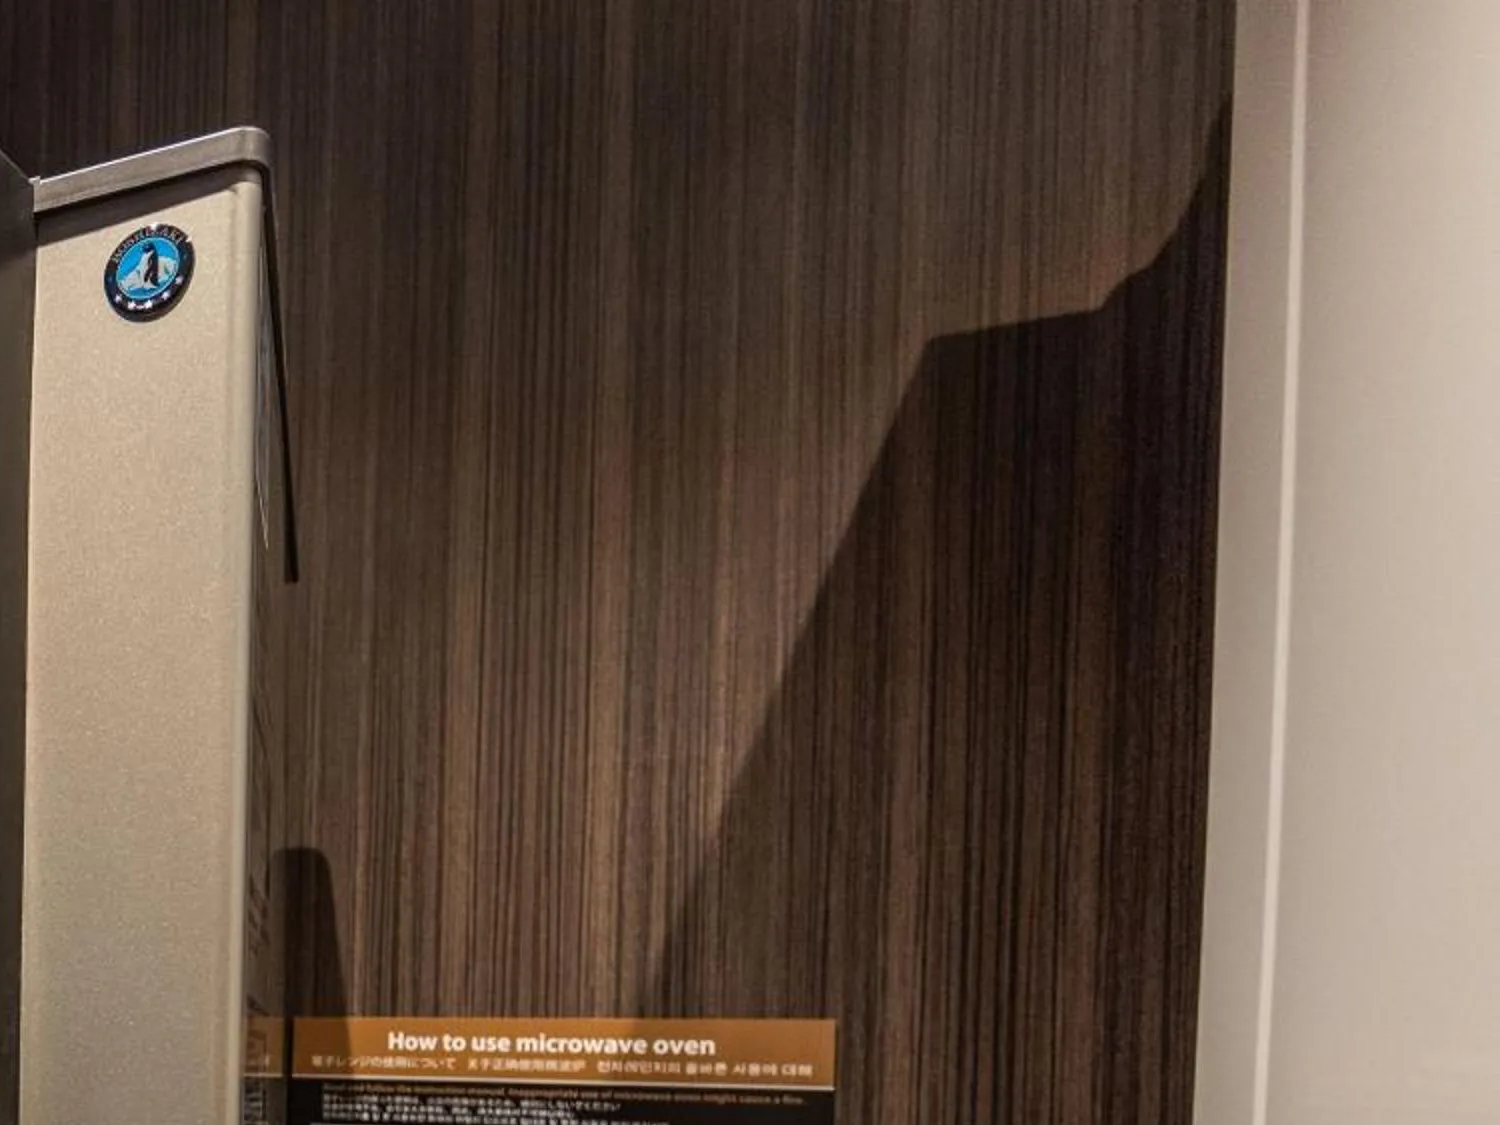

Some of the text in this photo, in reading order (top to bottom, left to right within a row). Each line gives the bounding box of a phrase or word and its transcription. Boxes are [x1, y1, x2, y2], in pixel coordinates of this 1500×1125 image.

[388, 1032, 716, 1055] How to use microwave oven
